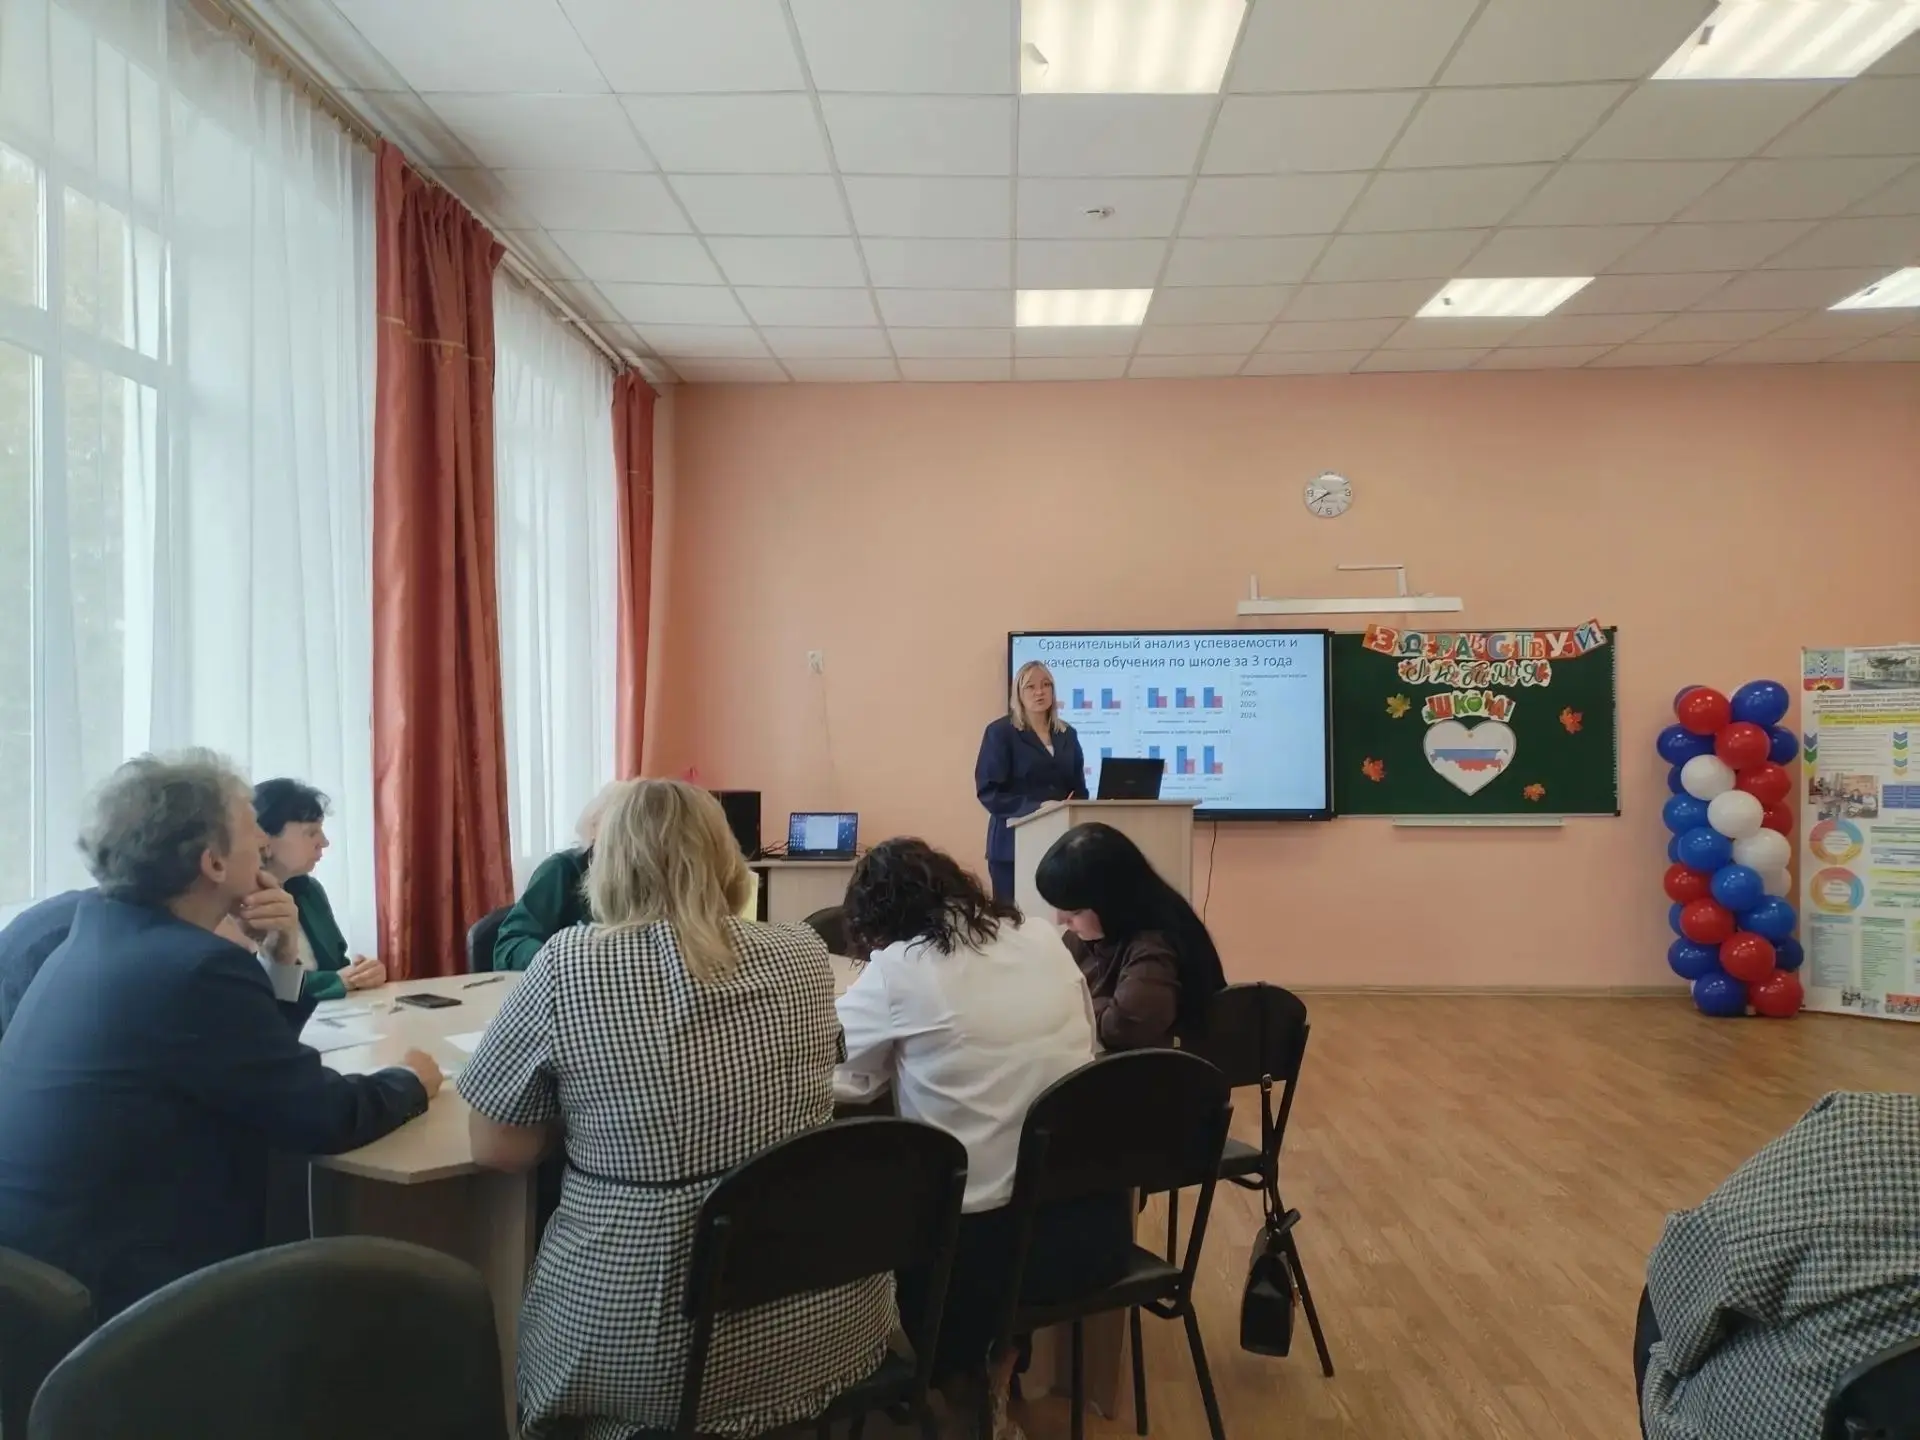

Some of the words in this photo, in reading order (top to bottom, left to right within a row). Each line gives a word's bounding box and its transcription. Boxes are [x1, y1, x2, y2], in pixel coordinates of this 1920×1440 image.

[1344, 488, 1352, 497] 3
[1038, 637, 1141, 652] Сравнительный
[1144, 639, 1190, 650] анализ
[1194, 638, 1287, 652] успеваемости
[1290, 638, 1299, 649] и
[1366, 621, 1604, 660] ЗДРАВСТВУЙ
[1043, 658, 1100, 669] качества
[1103, 655, 1165, 671] обучения
[1168, 657, 1186, 668] по
[1188, 657, 1232, 669] школе
[1233, 657, 1248, 668] за
[1251, 654, 1260, 668] 3
[1263, 656, 1293, 670] года
